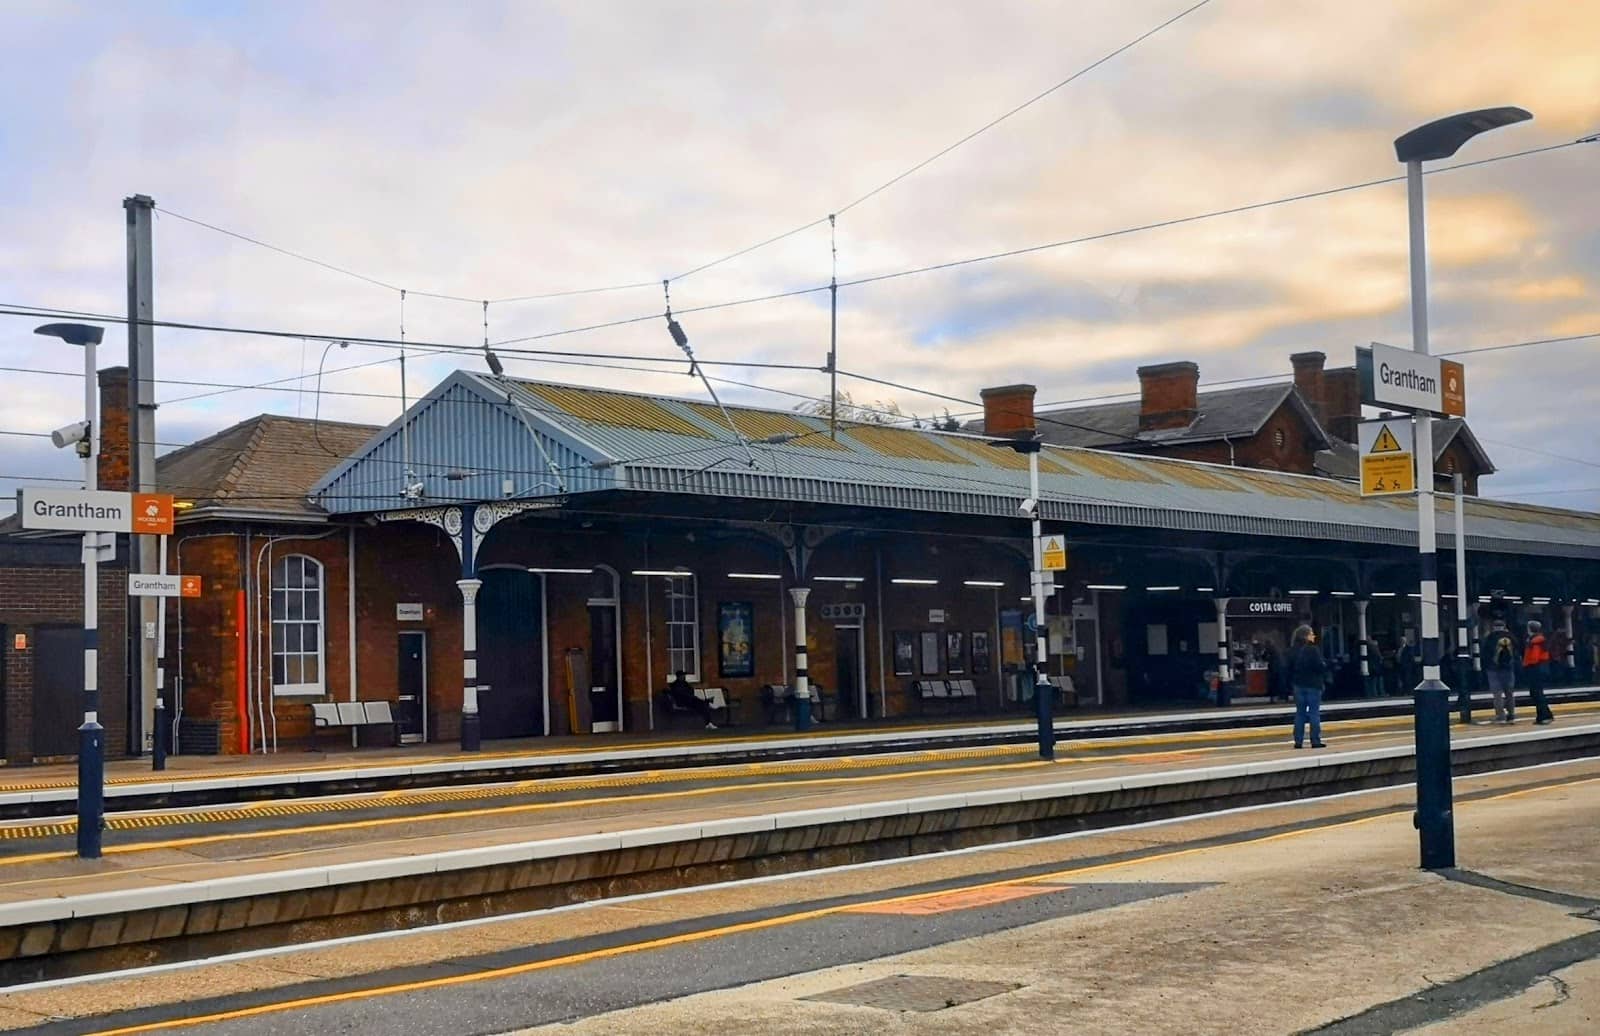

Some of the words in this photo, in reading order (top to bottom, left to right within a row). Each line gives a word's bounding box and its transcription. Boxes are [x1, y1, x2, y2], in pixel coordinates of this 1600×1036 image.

[1380, 362, 1436, 394] Grantham
[33, 500, 121, 520] Grantham
[134, 580, 176, 590] Grantham
[1249, 602, 1272, 613] COSTA
[1273, 602, 1292, 612] COFFEE
